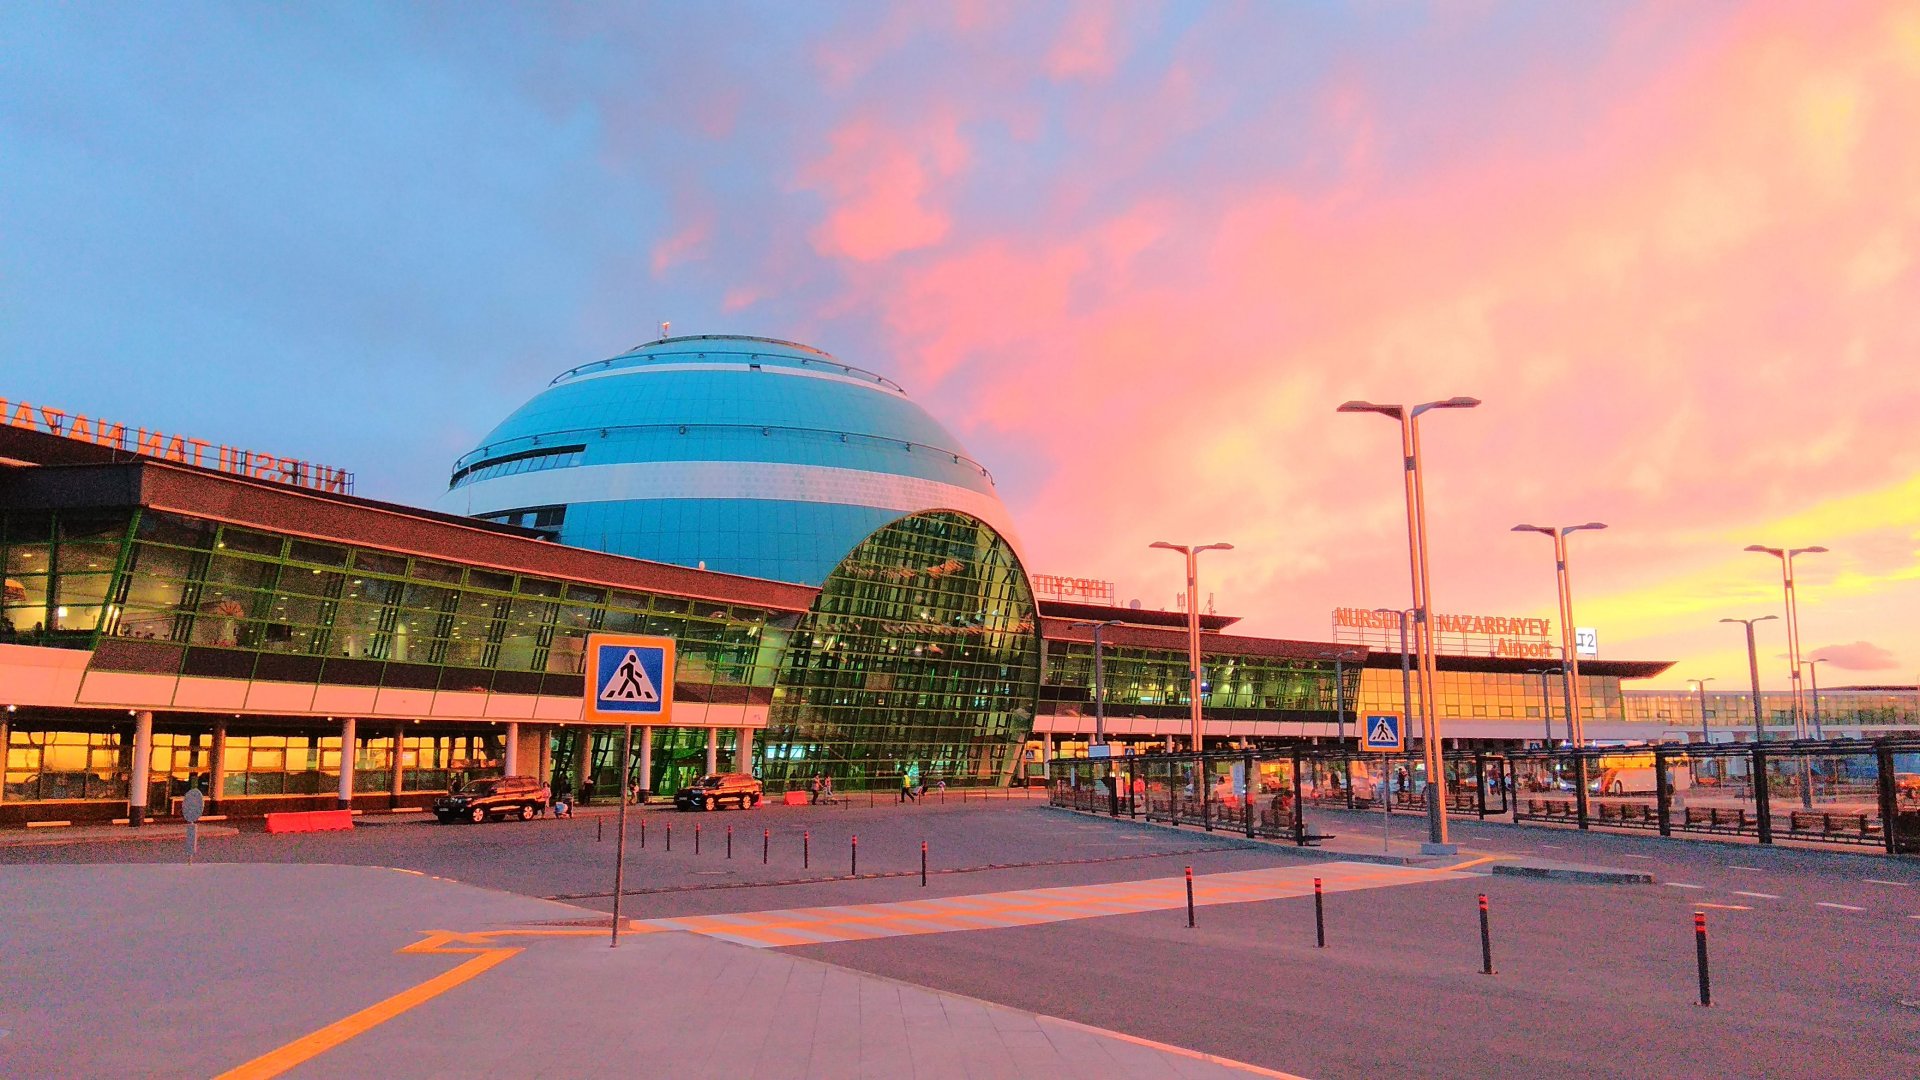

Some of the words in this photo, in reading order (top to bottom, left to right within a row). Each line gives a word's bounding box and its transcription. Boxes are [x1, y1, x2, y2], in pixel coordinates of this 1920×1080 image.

[1439, 614, 1550, 637] NAZARBAYEV
[1496, 638, 1553, 658] Airport
[1577, 633, 1595, 648] T2
